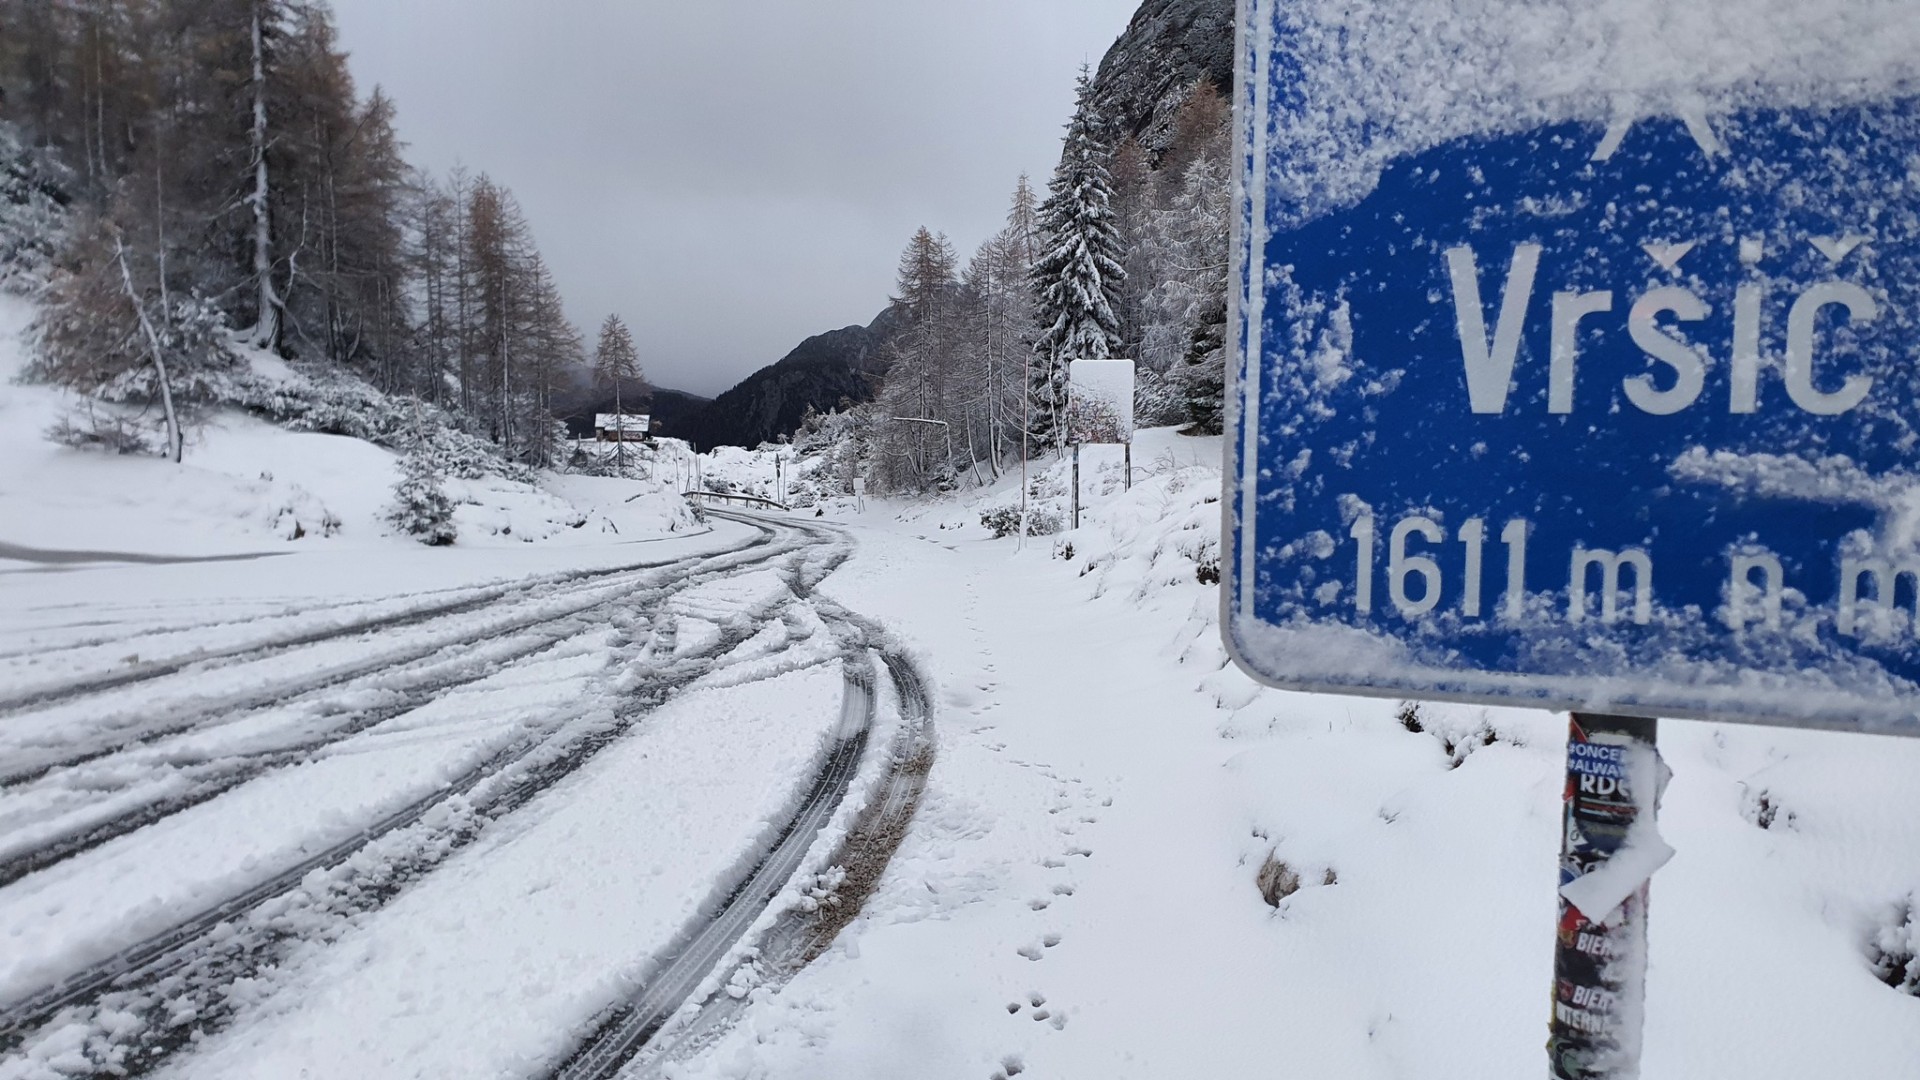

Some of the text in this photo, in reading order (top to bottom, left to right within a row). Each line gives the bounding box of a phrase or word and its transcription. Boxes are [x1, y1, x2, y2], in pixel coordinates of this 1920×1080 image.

[1446, 236, 1878, 416] Vršič
[1350, 515, 1527, 621] 1611
[1569, 547, 1653, 626] m
